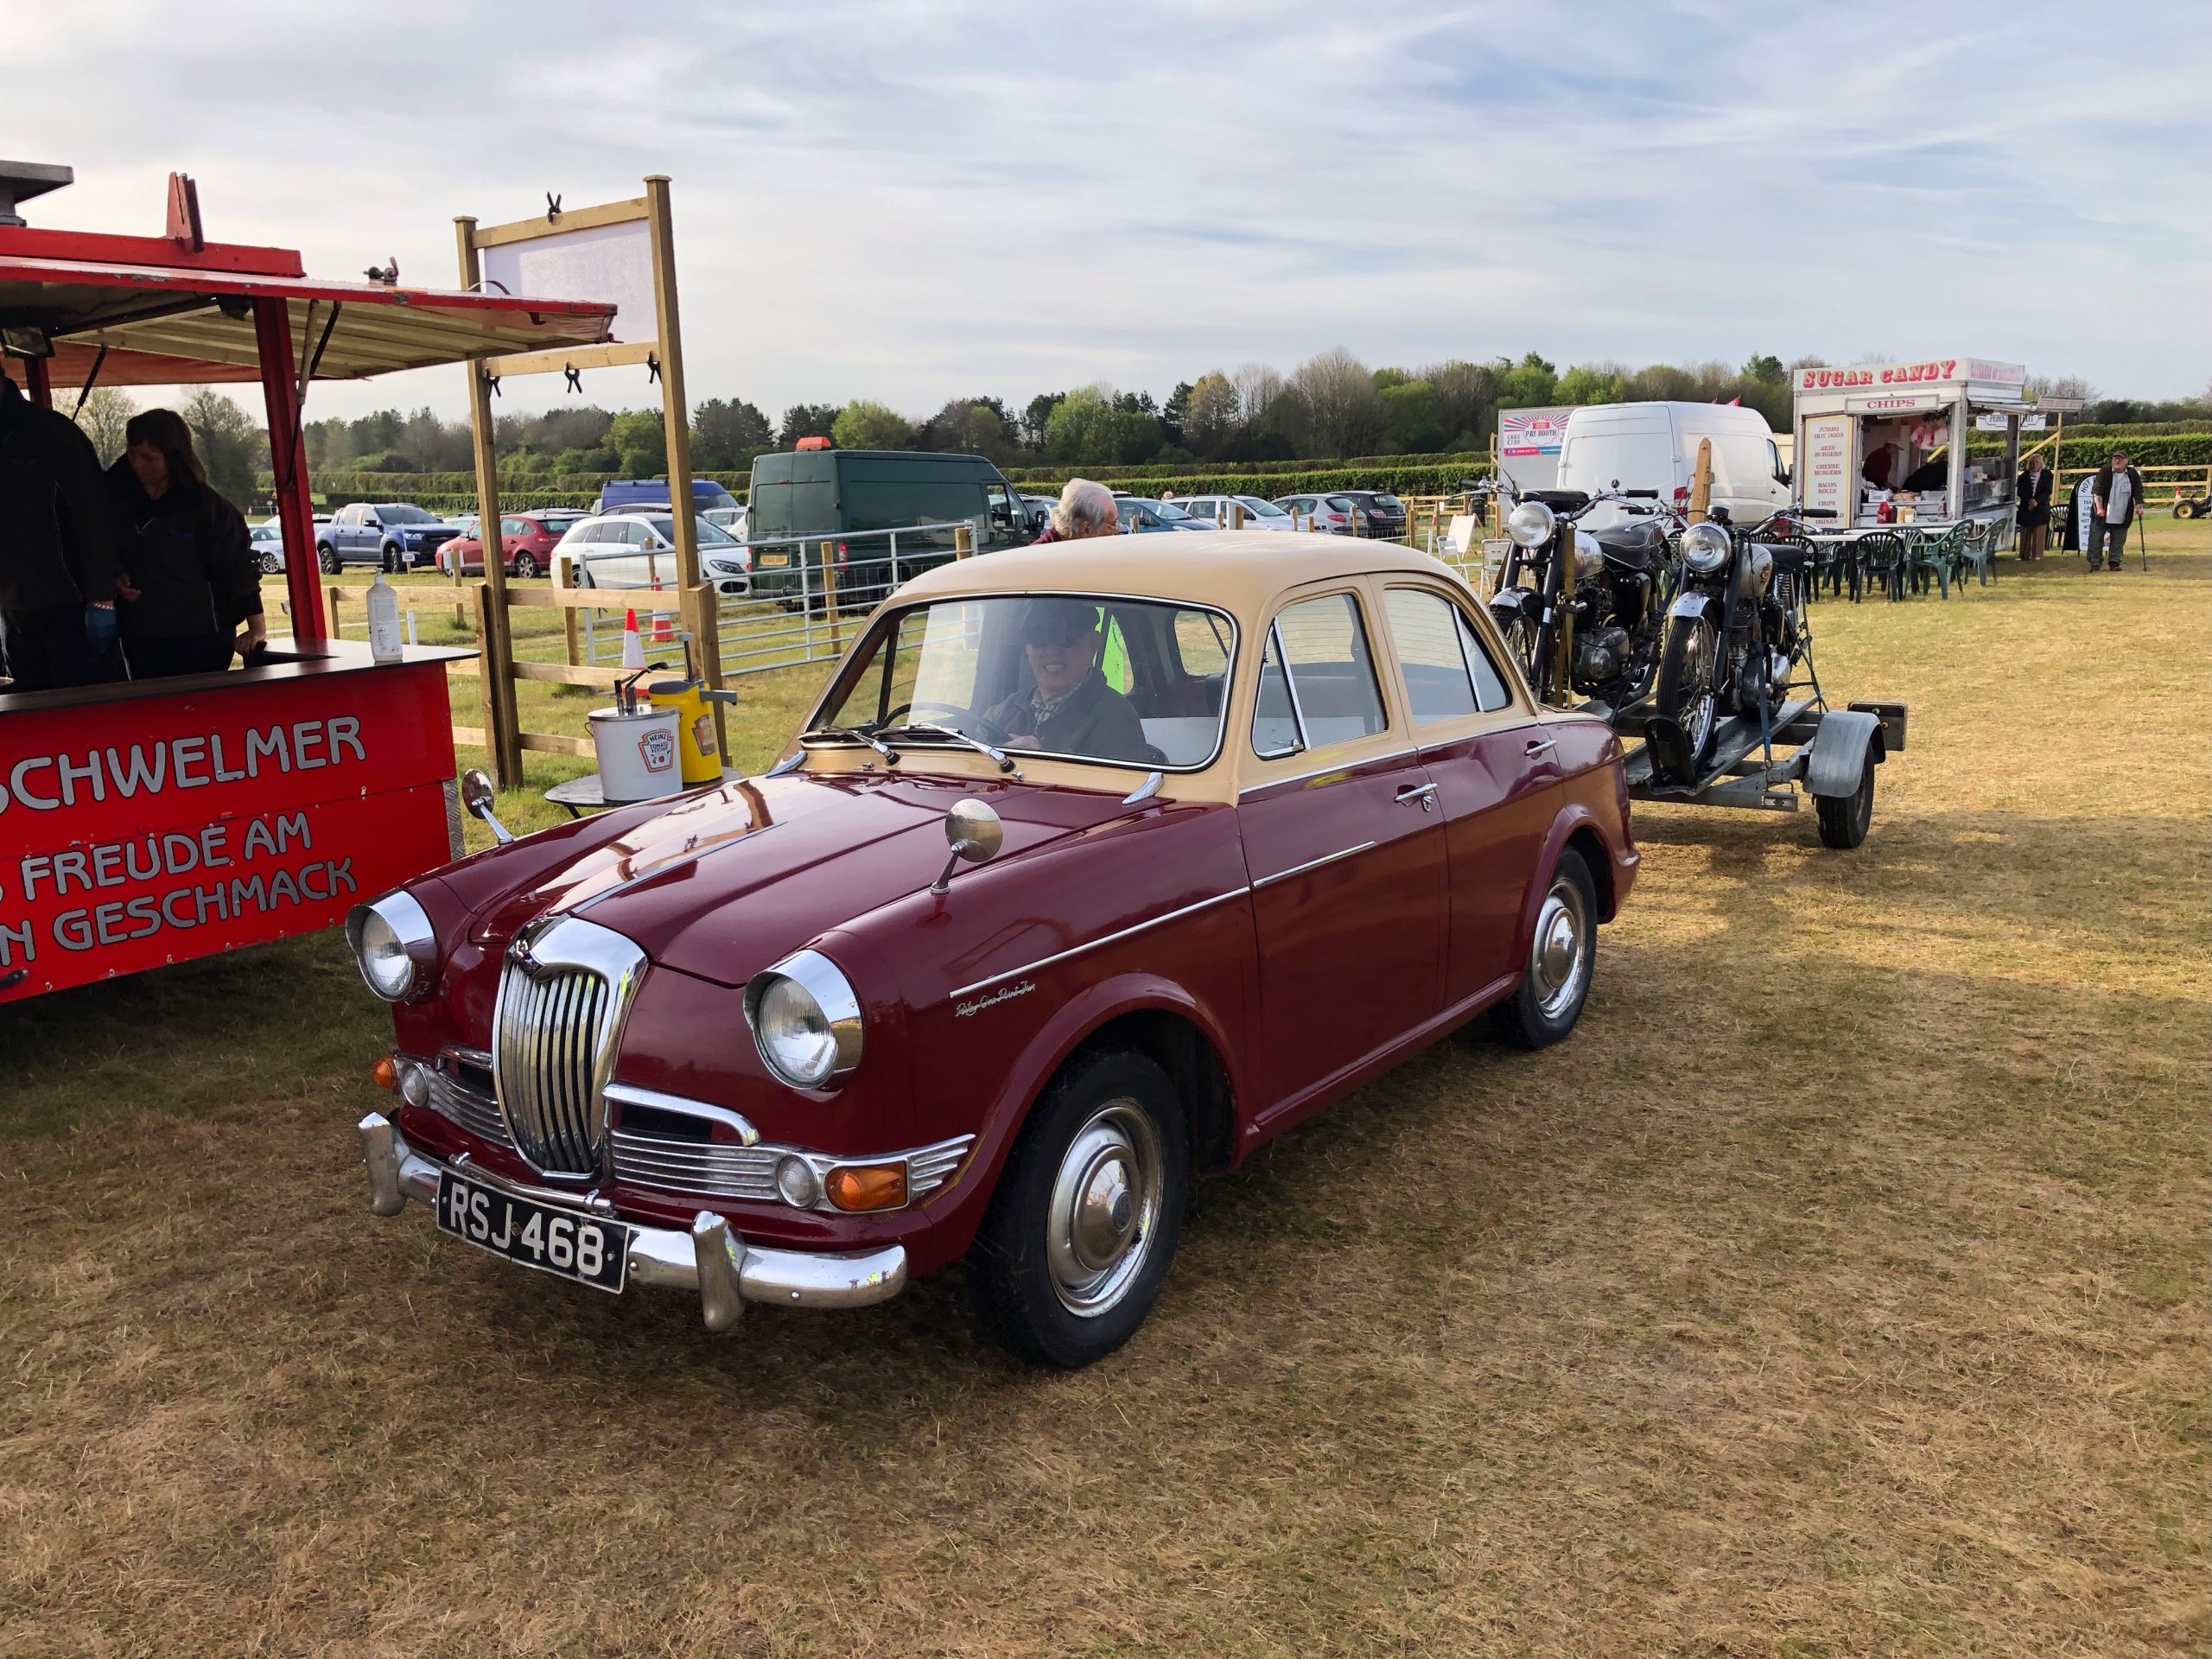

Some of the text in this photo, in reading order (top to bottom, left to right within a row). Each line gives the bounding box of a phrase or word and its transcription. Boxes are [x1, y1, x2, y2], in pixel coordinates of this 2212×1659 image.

[1803, 370, 1873, 388] SUGAR
[1880, 359, 1956, 383] CANDY
[1866, 398, 1916, 410] CHIPS
[649, 734, 667, 742] HEINZ
[21, 811, 312, 900] FREUDE AM
[53, 856, 357, 950] GESCHMACK
[450, 1182, 605, 1276] RSJ 468
